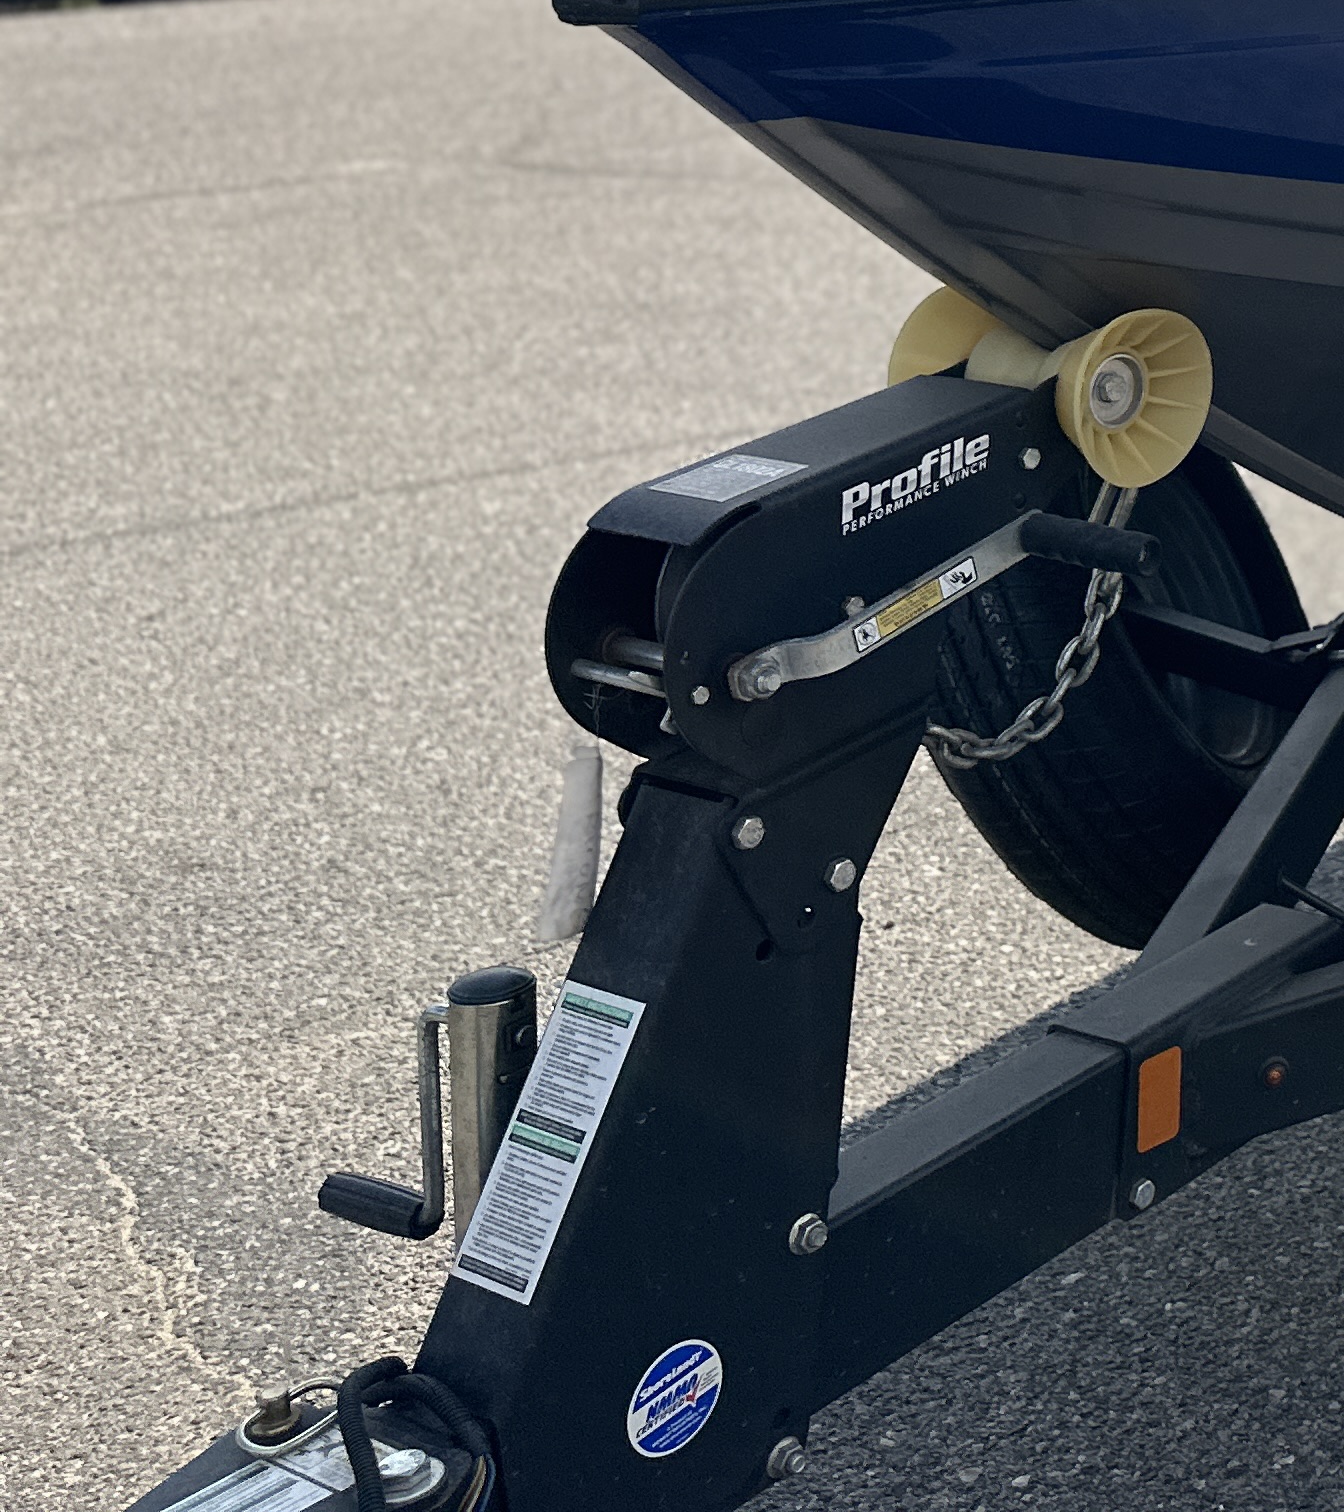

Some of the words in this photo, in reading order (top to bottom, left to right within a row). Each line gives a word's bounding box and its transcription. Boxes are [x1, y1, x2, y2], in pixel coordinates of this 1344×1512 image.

[842, 434, 990, 525] Profile
[842, 481, 940, 536] PERFORMANCE
[944, 459, 988, 488] WINCH
